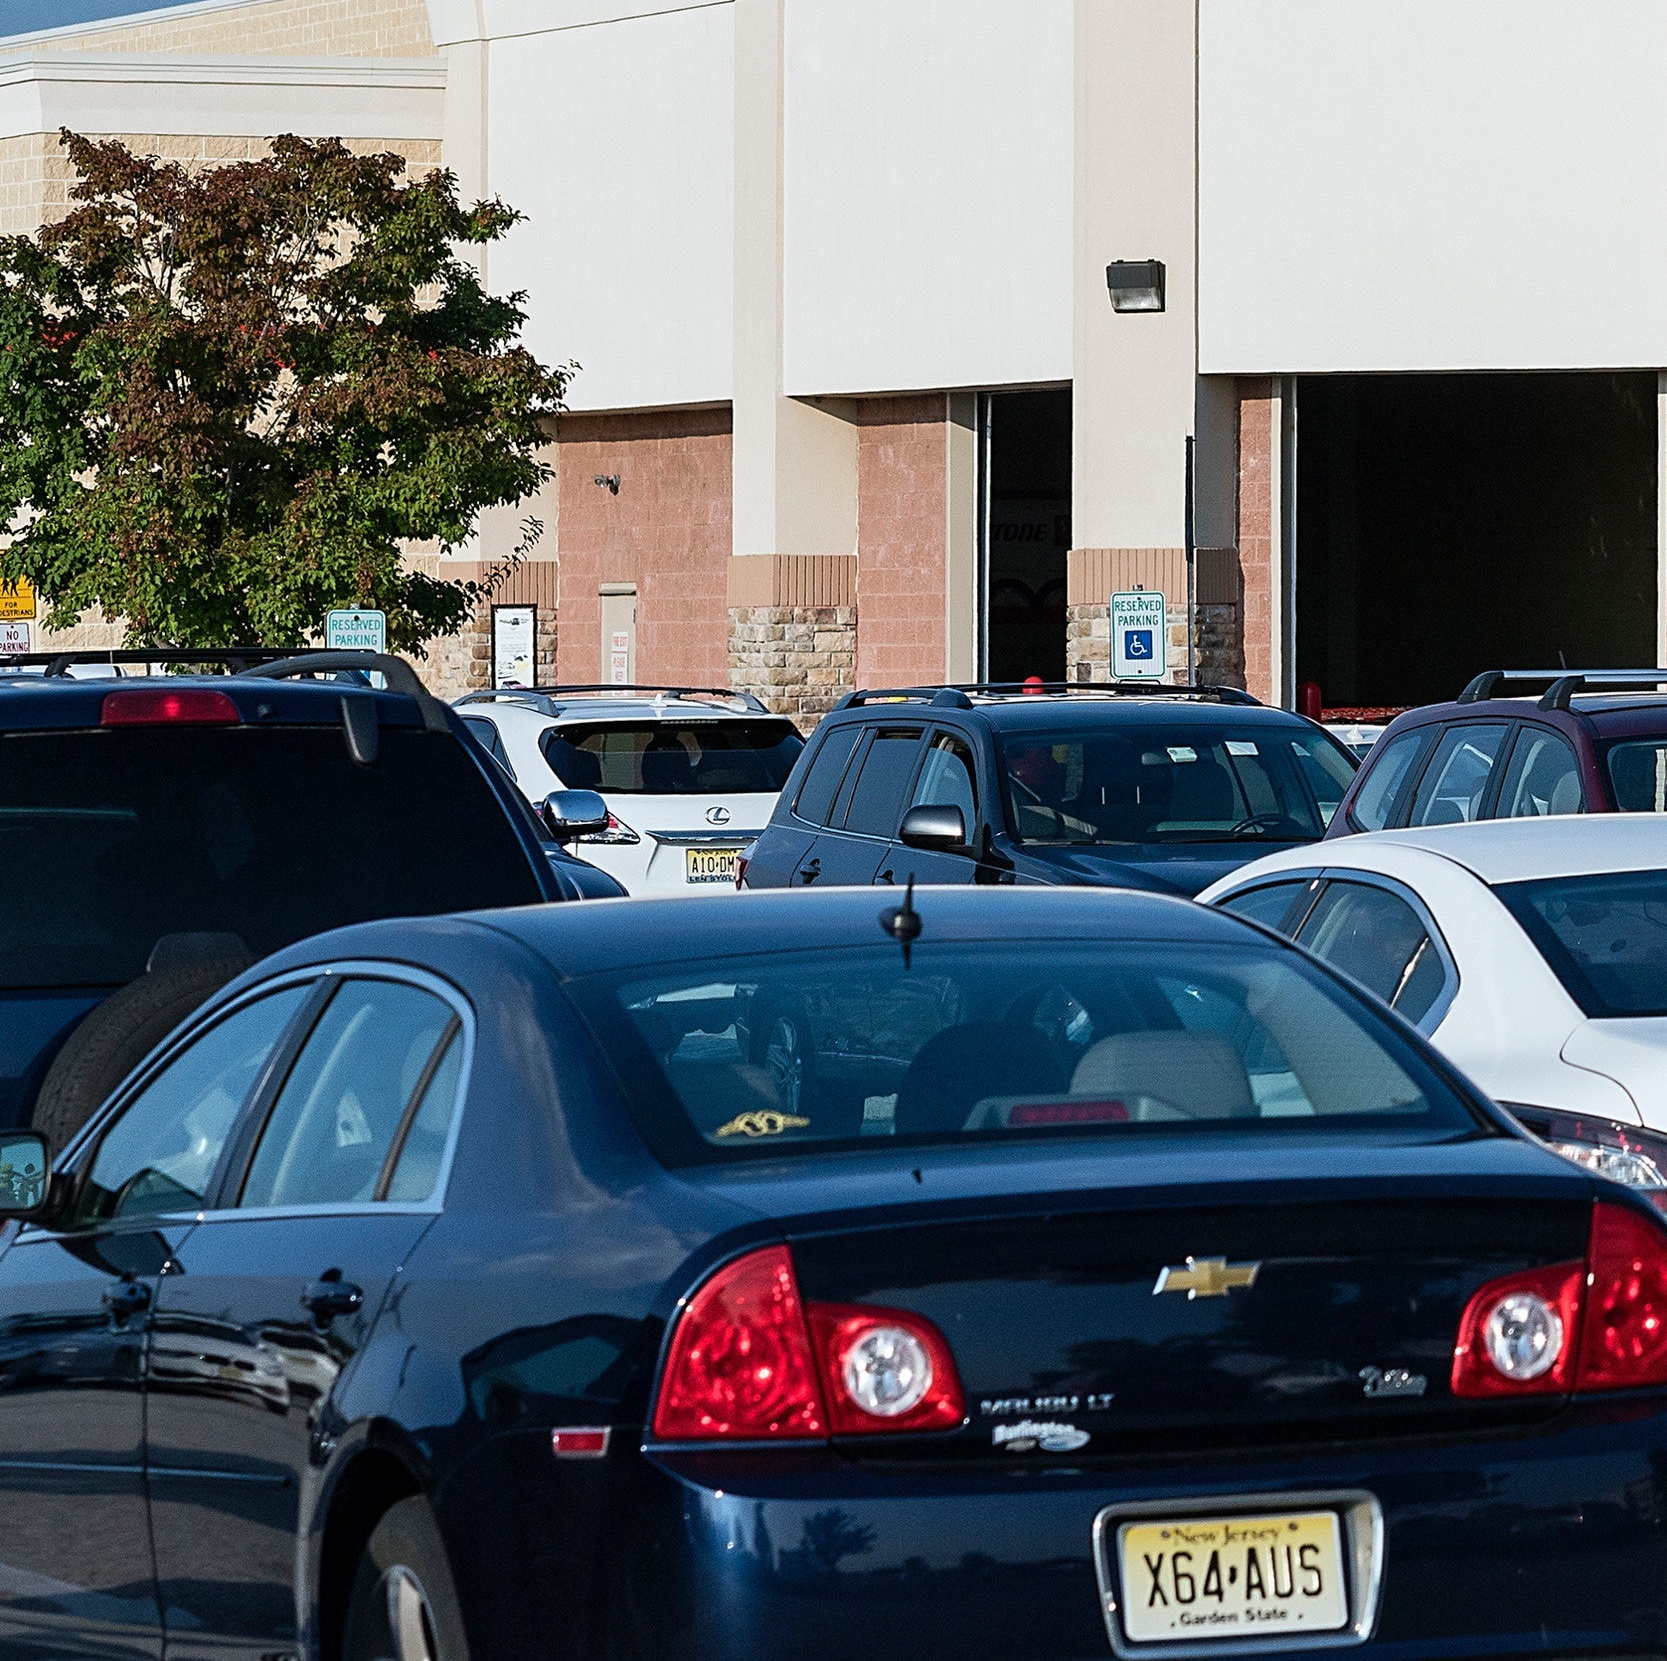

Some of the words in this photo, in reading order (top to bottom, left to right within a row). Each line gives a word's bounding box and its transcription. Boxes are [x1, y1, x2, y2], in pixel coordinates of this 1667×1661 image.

[1114, 600, 1162, 612] RESERVED
[331, 619, 381, 631] RESERVED
[1117, 615, 1159, 627] PARKING
[6, 630, 19, 641] NO
[334, 634, 378, 646] PARKING
[1174, 1528, 1217, 1545] New
[1223, 1525, 1281, 1546] Jersey
[1180, 1611, 1239, 1628] Garden
[1246, 1608, 1289, 1622] State
